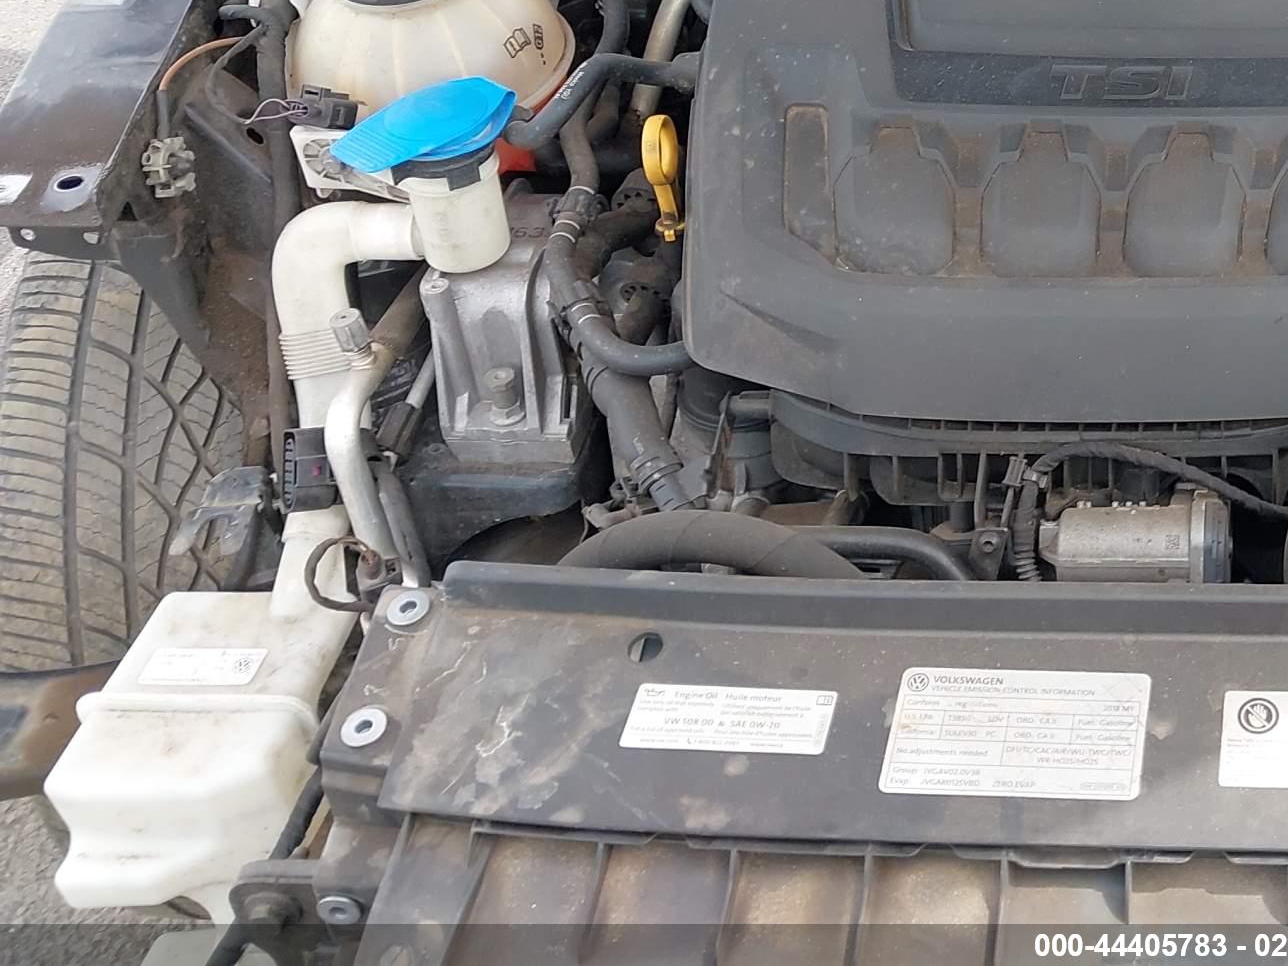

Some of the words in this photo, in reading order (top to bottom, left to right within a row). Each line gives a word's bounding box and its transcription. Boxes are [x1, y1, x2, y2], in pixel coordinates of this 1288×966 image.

[1049, 64, 1194, 100] TSI
[933, 675, 1004, 686] VOLKSWAGEN
[674, 691, 704, 701] Engine
[705, 692, 718, 700] Oil
[1040, 688, 1096, 696] INFORMATION
[725, 693, 749, 701] Huile
[750, 694, 782, 703] moteur
[664, 717, 680, 725] VW
[682, 717, 700, 726] 508
[700, 718, 714, 726] 00
[729, 720, 747, 728] SAE
[748, 721, 781, 729] 0W-20
[908, 747, 958, 756] adjustments
